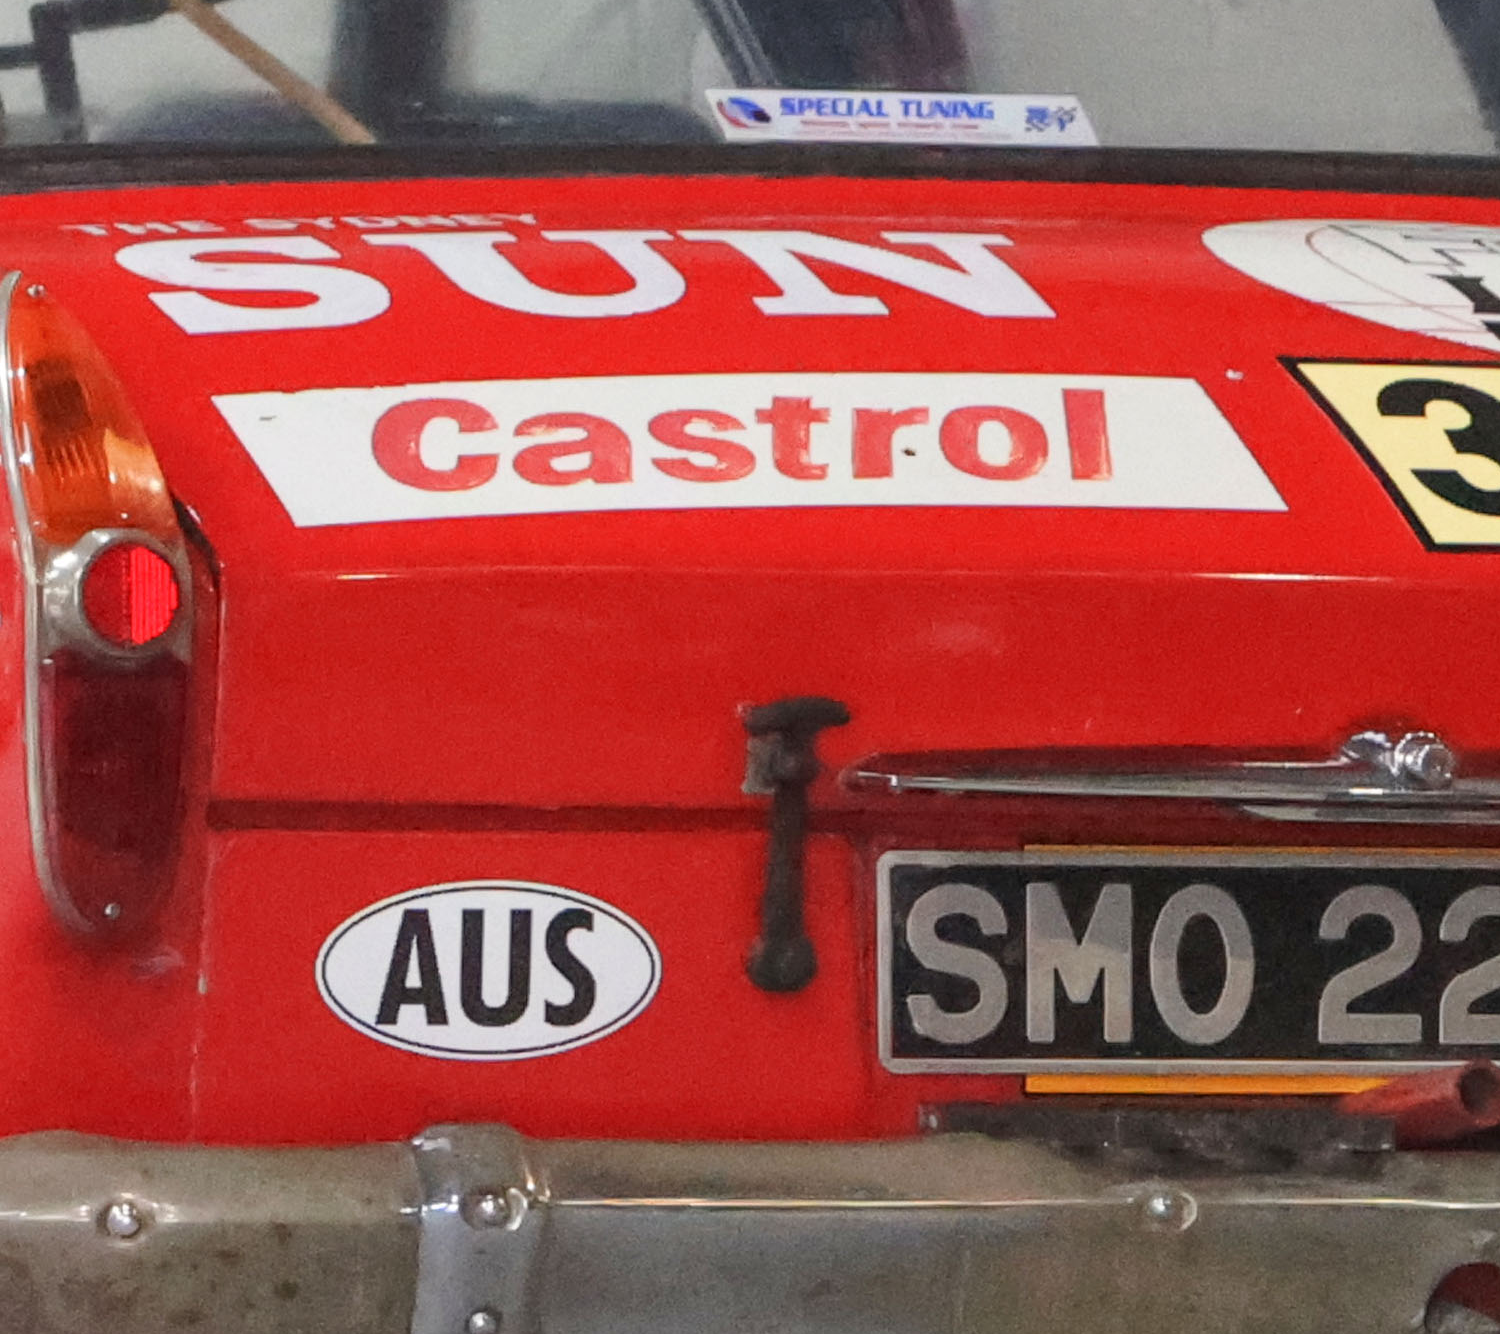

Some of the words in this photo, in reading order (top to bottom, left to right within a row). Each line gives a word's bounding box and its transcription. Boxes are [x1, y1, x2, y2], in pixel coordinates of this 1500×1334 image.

[780, 97, 887, 117] SPECIAL
[898, 100, 995, 120] TUNING
[115, 231, 1056, 335] SUN
[371, 389, 1113, 493] Castrol
[375, 906, 599, 1029] AUS
[905, 881, 1256, 1045] SMO
